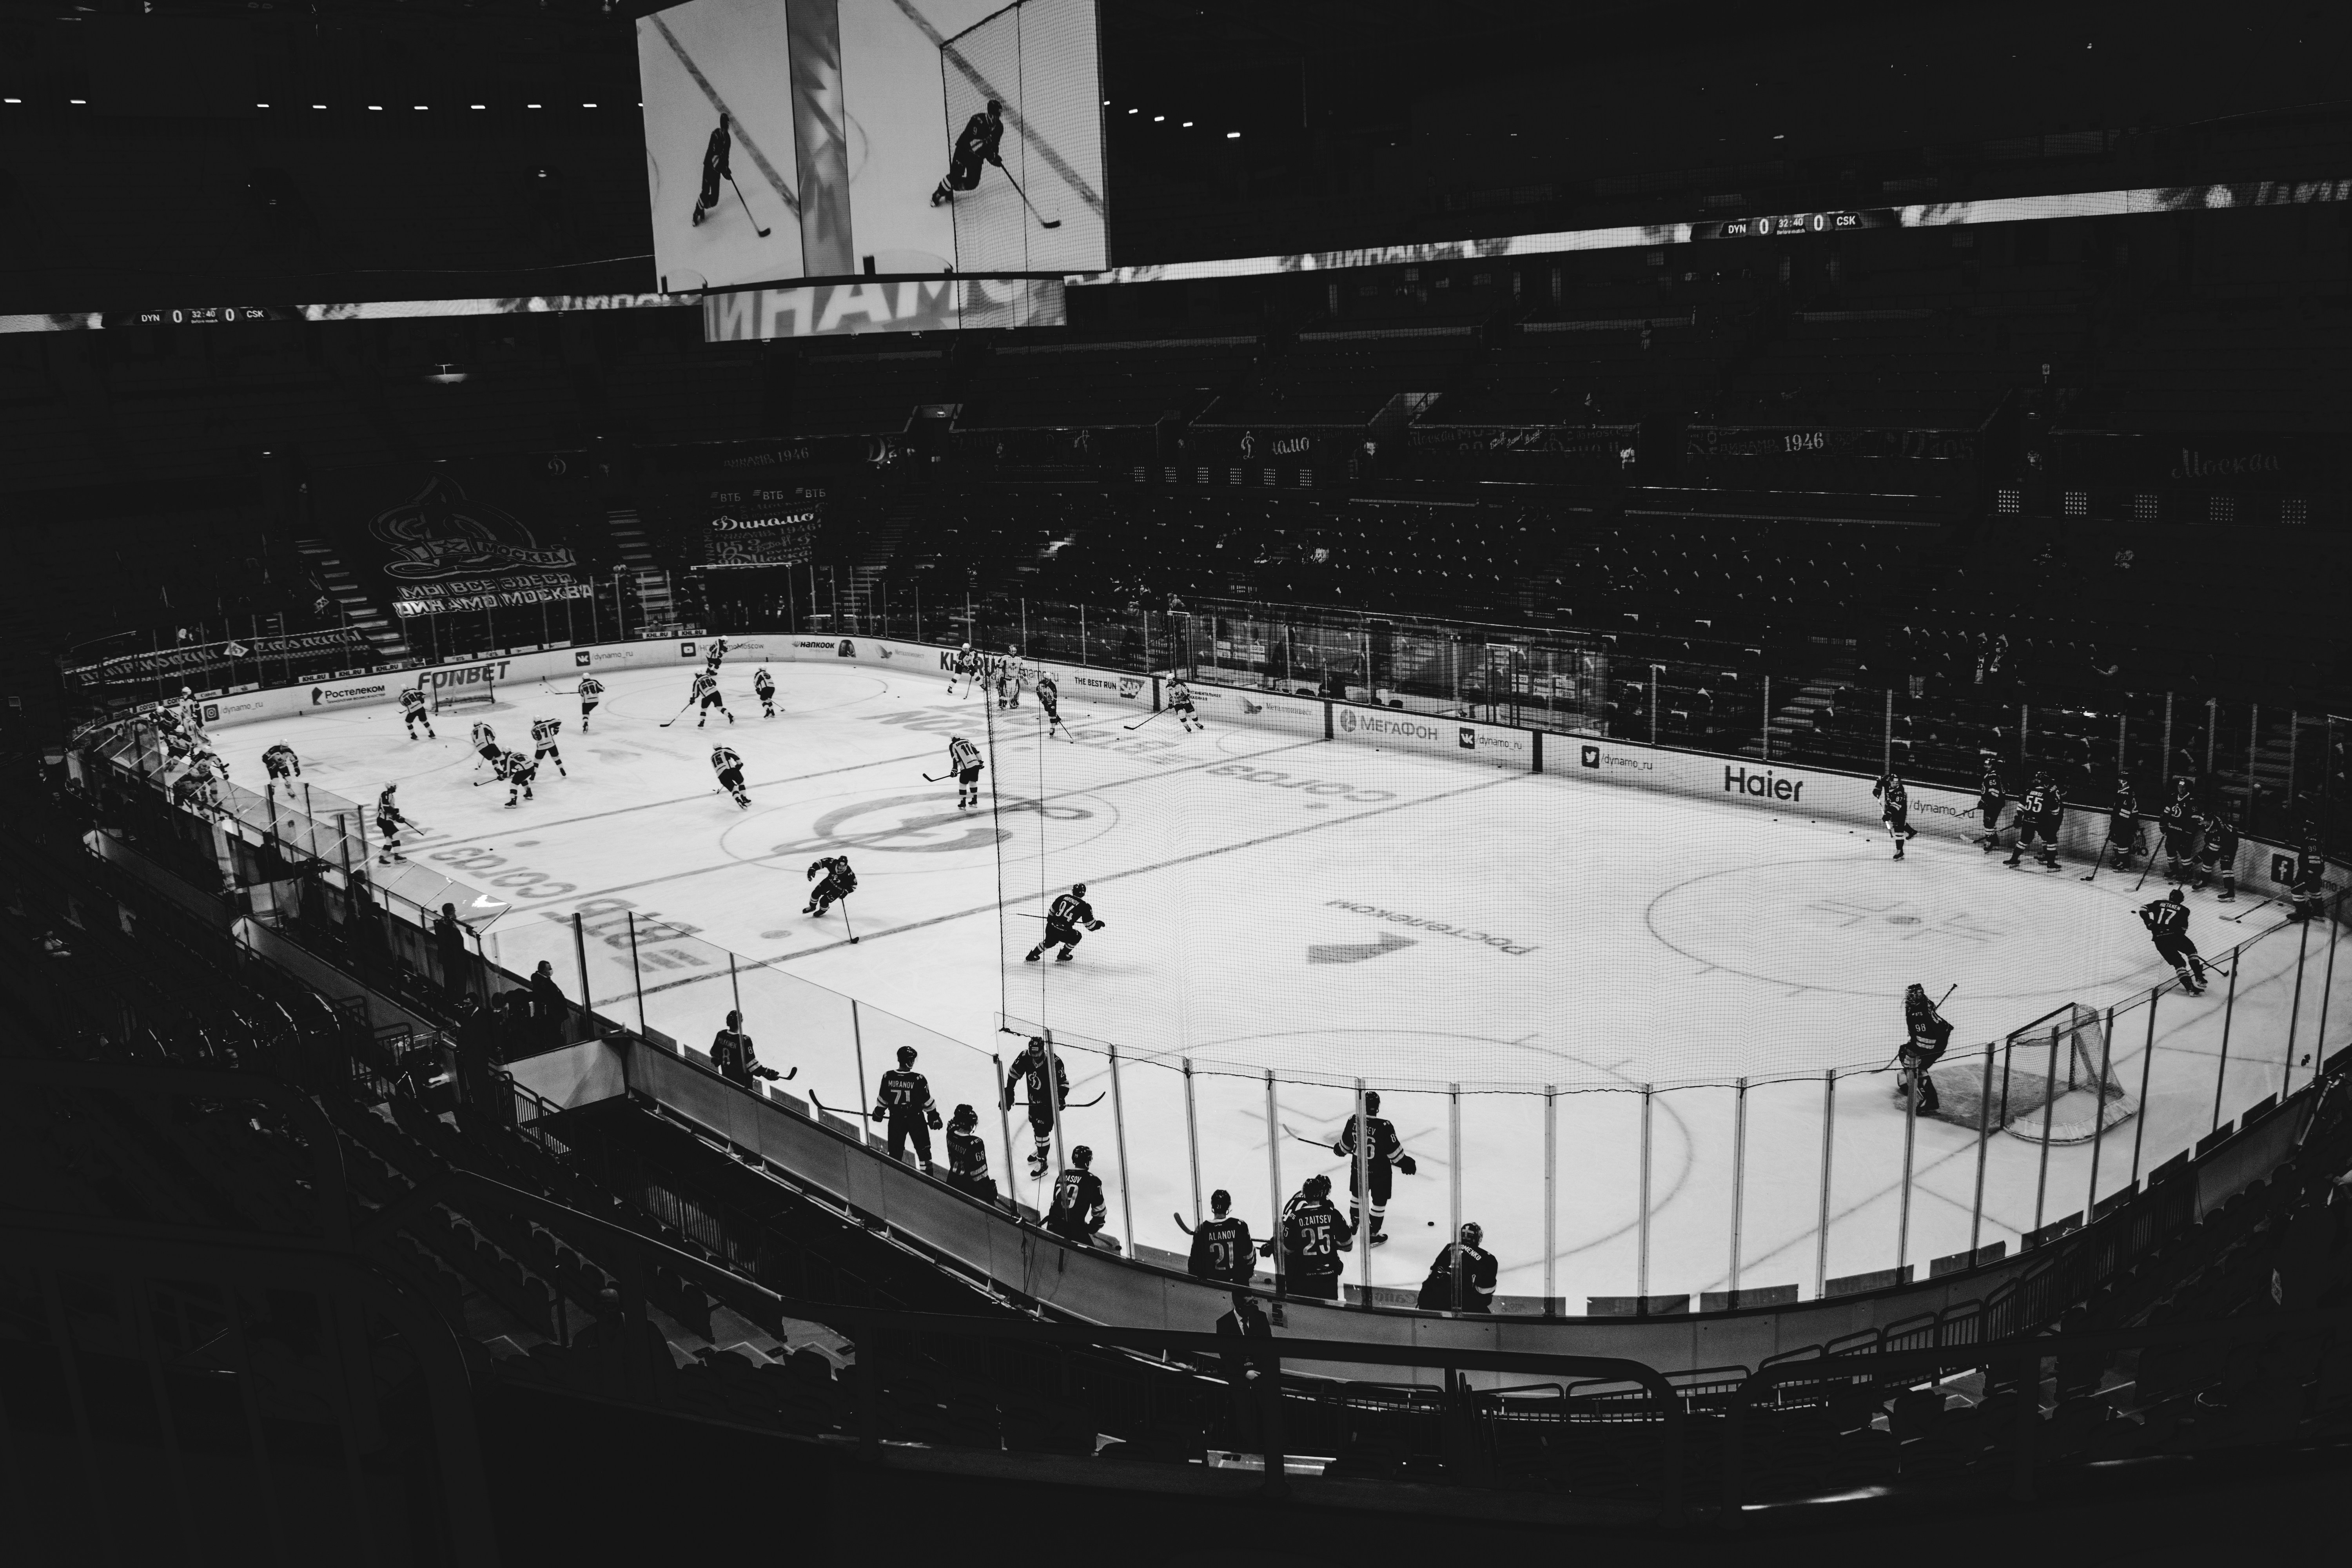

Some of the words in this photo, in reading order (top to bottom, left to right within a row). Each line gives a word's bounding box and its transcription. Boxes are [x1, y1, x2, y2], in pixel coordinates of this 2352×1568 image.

[1728, 224, 1746, 234] DYN
[1759, 218, 1769, 234] 0
[1778, 218, 1804, 228] 32:40
[1814, 215, 1823, 231] 0
[1837, 216, 1856, 226] CSK
[141, 314, 160, 322] DYN
[172, 310, 183, 323] 0
[225, 309, 234, 321] 0
[1784, 432, 1824, 452] 1946
[777, 446, 809, 463] 1946
[2171, 447, 2281, 479] Москва
[720, 493, 741, 502] ВТБ
[763, 490, 784, 500] ВТБ
[806, 488, 826, 498] ВТБ
[712, 513, 814, 531] Динамо
[481, 540, 563, 562] МОСКВА
[397, 584, 450, 600] МЫ
[448, 579, 499, 595] ВСЕ
[498, 573, 577, 590] ЗДЕСЬ
[393, 595, 500, 617] ДИНАМО
[501, 584, 593, 607] МОСКВА
[895, 649, 925, 659] Металлоинвест
[339, 669, 362, 677] KHL.RU
[376, 664, 399, 672] KHL.RU
[302, 674, 326, 682] KHL.RU
[417, 661, 511, 691] FONBET
[1075, 677, 1086, 685] THE
[1088, 679, 1102, 688] BEST
[1104, 681, 1117, 690] RUN
[325, 685, 385, 699] Ростелеком
[1120, 680, 1140, 695] SAP
[1190, 689, 1221, 698] НТИНЕНТАЛЬНАЯ
[220, 701, 263, 715] /dynamo_ru
[1266, 702, 1312, 717] Металлоинвест
[1361, 715, 1438, 741] МЕГАФОН
[1477, 733, 1522, 750] /dynamo_ru
[1601, 755, 1653, 771] /dynamo_ru
[1725, 765, 1803, 802] Haier
[2025, 795, 2044, 813] 55
[1063, 896, 1080, 906] MIRONOV
[1056, 901, 1074, 922] 94
[2157, 908, 2177, 925] 17
[1915, 1024, 1926, 1032] 98
[722, 1047, 730, 1067] 8
[748, 1046, 753, 1055] 8
[888, 1080, 914, 1090] MURANOV
[890, 1089, 911, 1105] 71
[975, 1151, 985, 1161] 68
[1299, 1214, 1332, 1227] O.ZAITSEV
[1209, 1230, 1236, 1241] ALANOV
[1301, 1225, 1331, 1256] 25
[1209, 1241, 1234, 1270] 21
